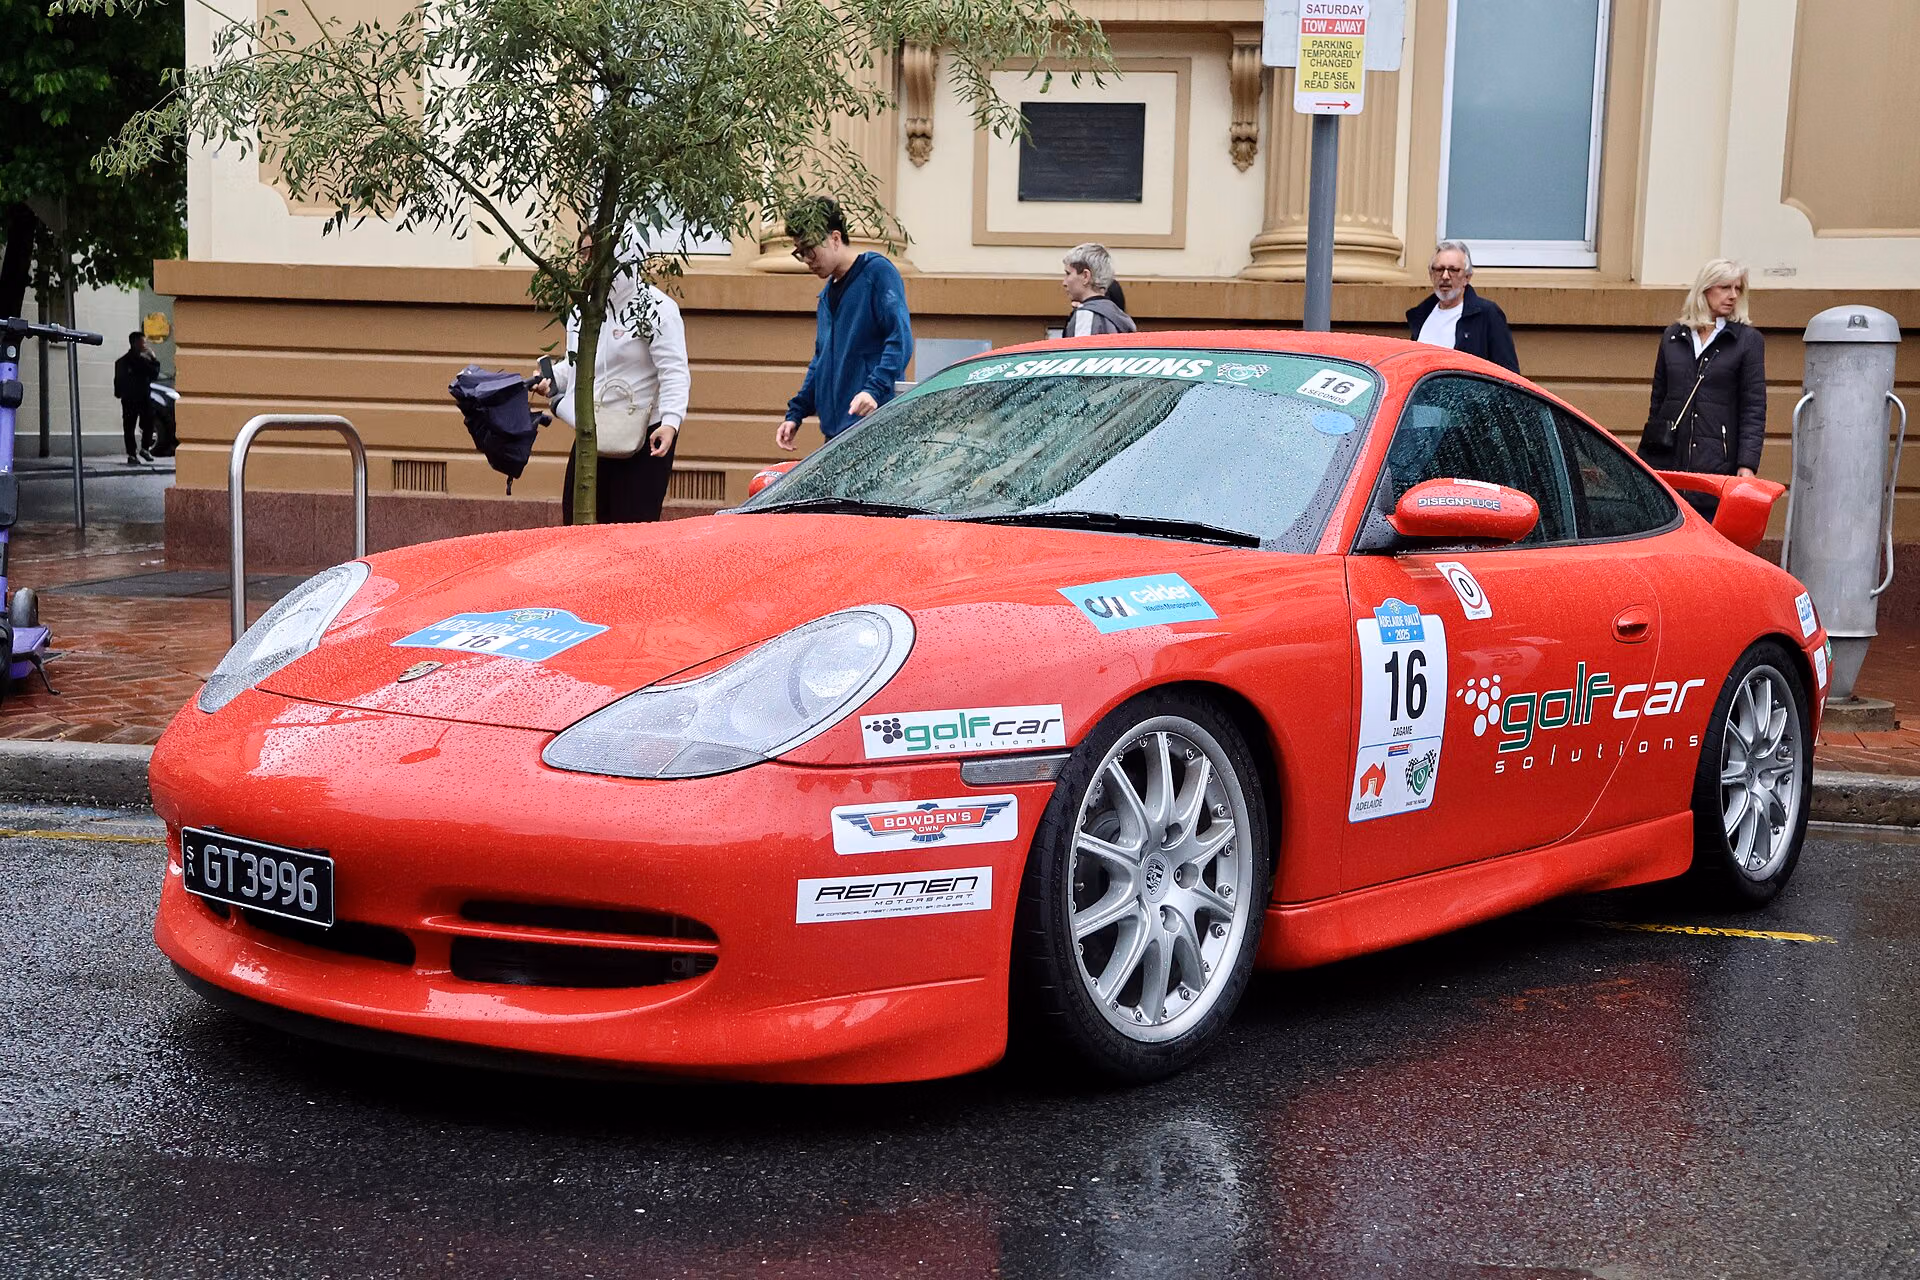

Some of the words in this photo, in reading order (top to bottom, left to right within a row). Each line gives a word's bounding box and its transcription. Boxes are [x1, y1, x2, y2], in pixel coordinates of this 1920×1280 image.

[1306, 4, 1364, 15] SATURDAY
[1304, 20, 1327, 32] TOW
[1334, 21, 1363, 33] AWAY
[1312, 40, 1353, 50] PARKING
[1302, 49, 1361, 59] TEMPORARILY
[1310, 59, 1353, 68] CHANGED
[1312, 71, 1349, 81] PLEASE
[1304, 80, 1329, 89] READ
[1334, 80, 1356, 90] SIGN
[1003, 357, 1214, 378] SHANNONS
[1320, 377, 1355, 394] 16
[1308, 388, 1347, 404] SECONDS
[1129, 584, 1192, 604] calder
[1458, 577, 1474, 598] 0
[1377, 614, 1405, 628] ADELAIDE
[1404, 612, 1421, 626] RALLY
[428, 619, 523, 637] ADELAIDE
[513, 626, 590, 644] RALLY
[1395, 629, 1410, 640] 2025
[458, 634, 500, 649] 16
[1384, 649, 1428, 722] 16
[1392, 725, 1413, 737] ZAGAME
[934, 738, 1047, 750] solutions
[1494, 735, 1699, 774] solutions
[1355, 799, 1383, 812] ADELAIDE
[883, 811, 972, 828] BOWDEN'S
[203, 844, 318, 912] GT3996
[815, 876, 979, 901] RENNEN
[874, 894, 974, 906] MOTORSPORT
